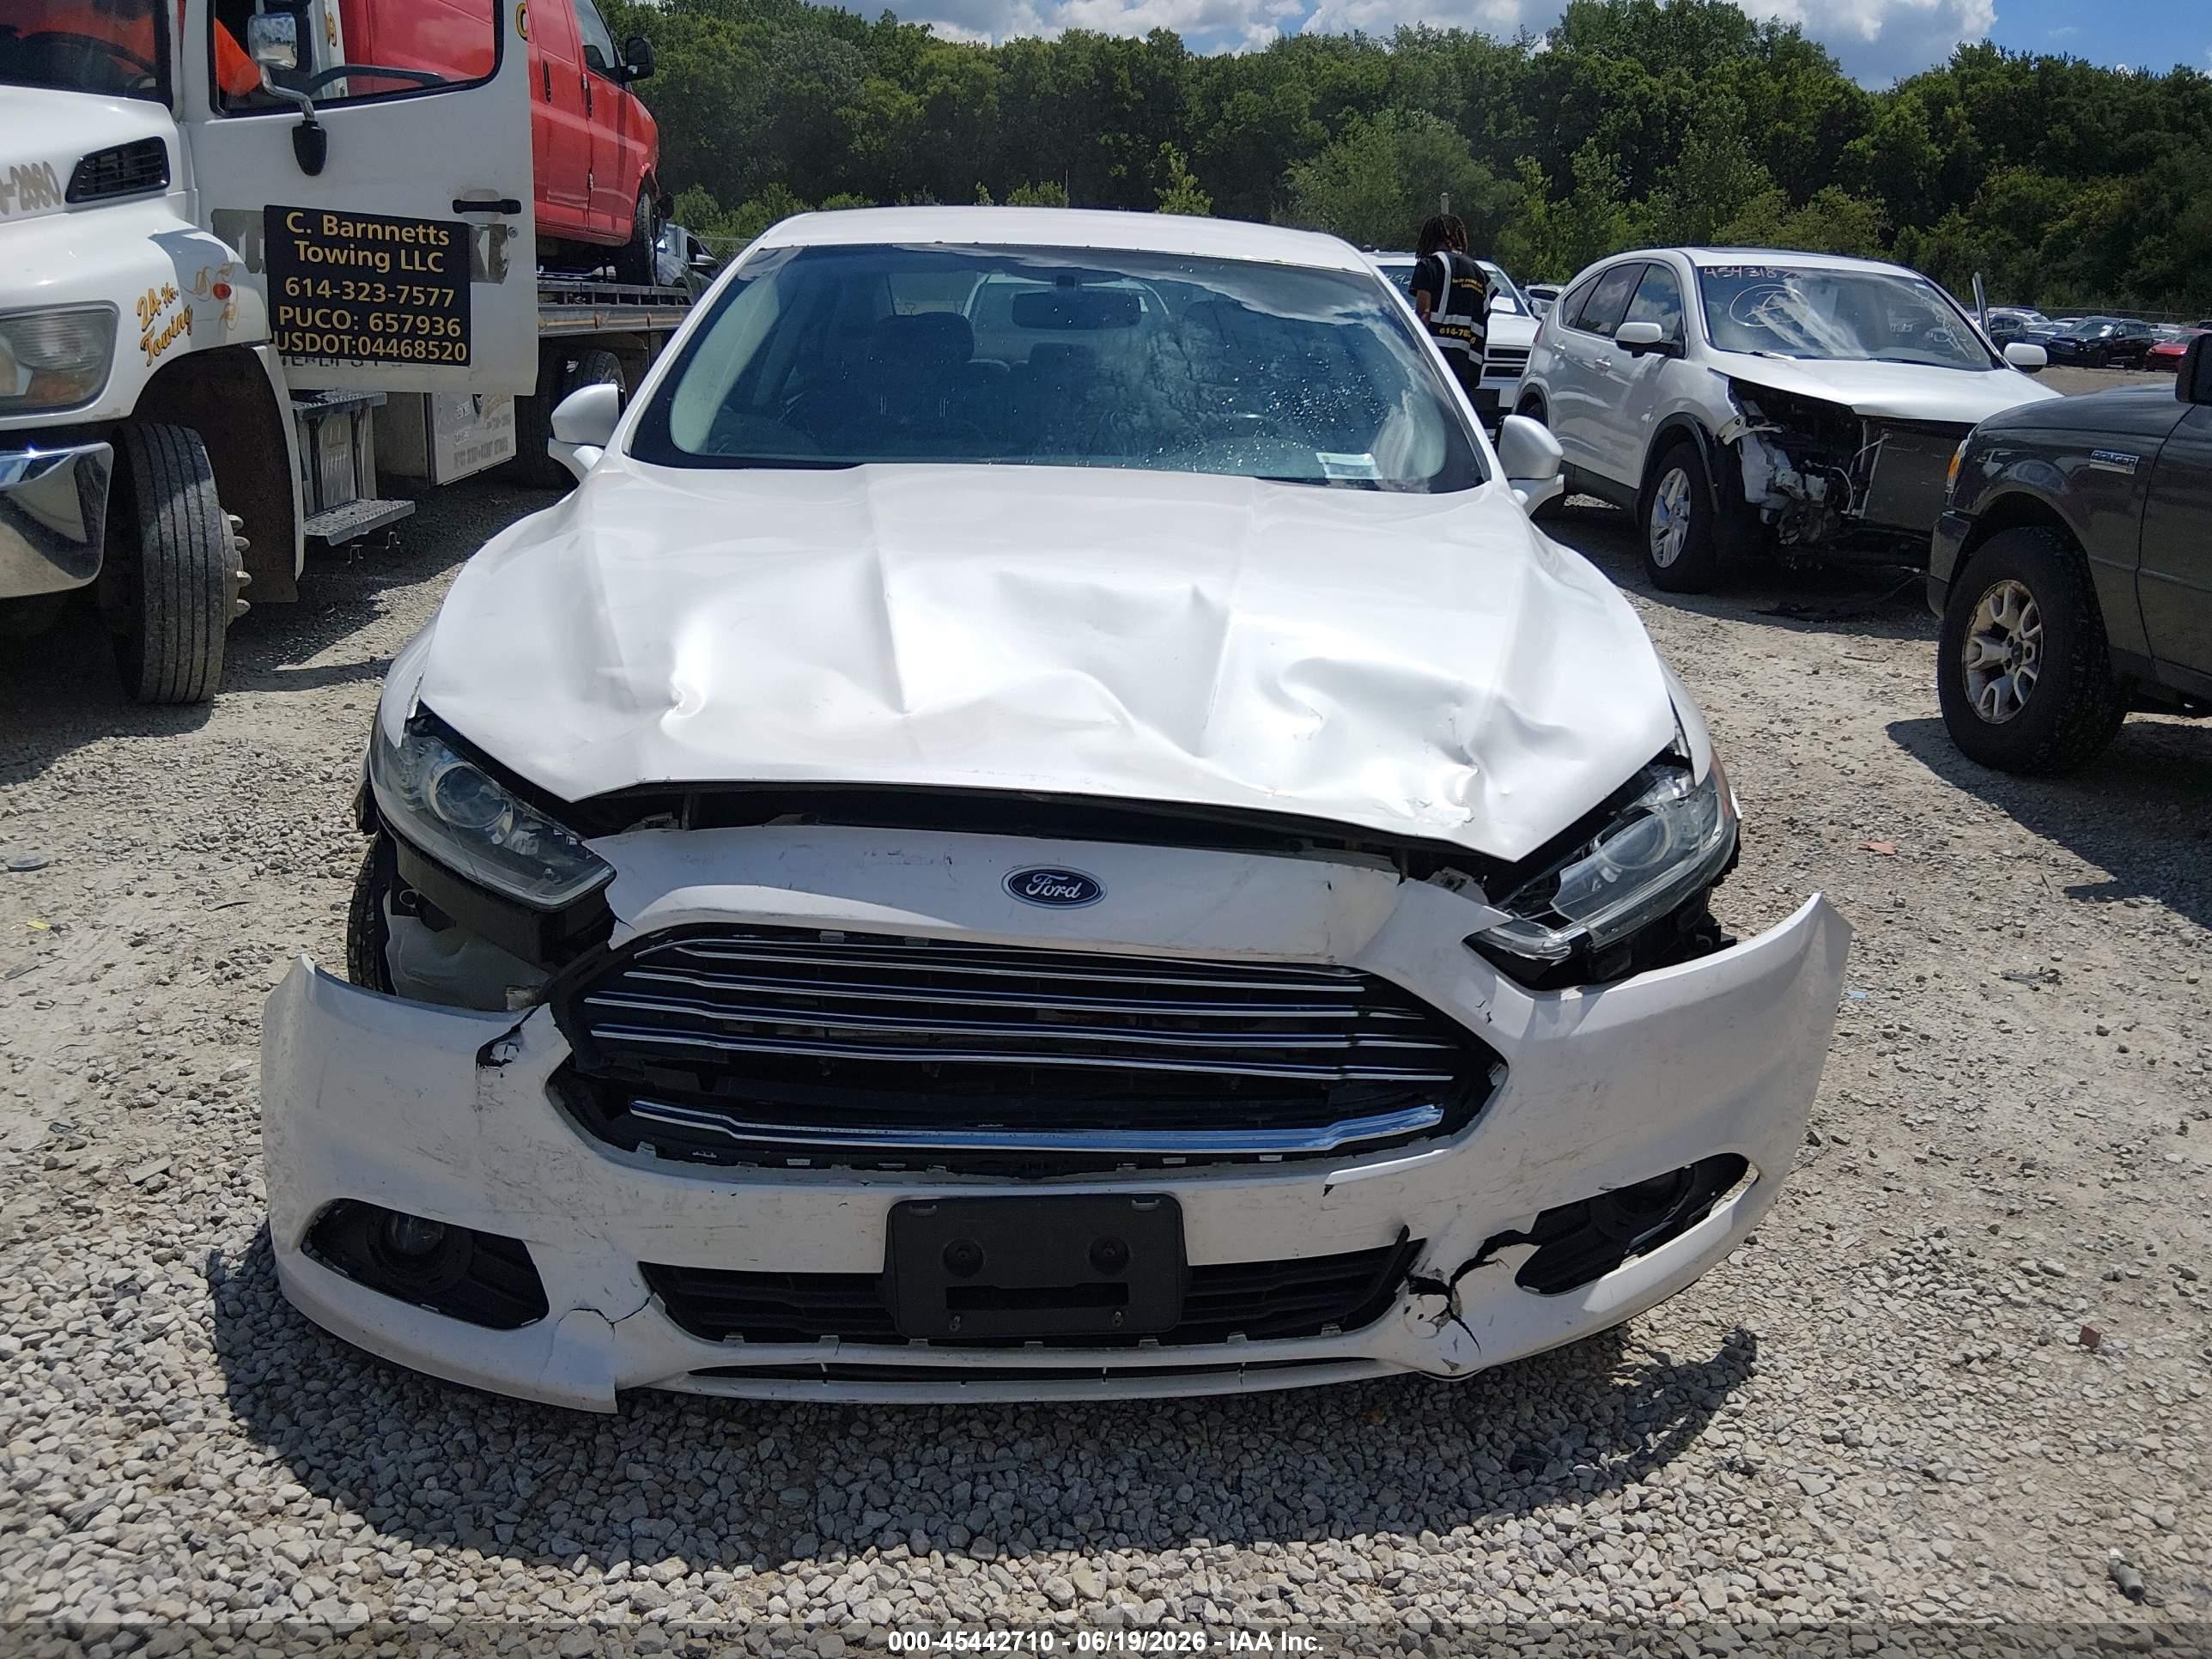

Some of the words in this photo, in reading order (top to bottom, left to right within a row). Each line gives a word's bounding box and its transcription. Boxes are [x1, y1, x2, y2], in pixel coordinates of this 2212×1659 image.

[286, 212, 312, 234] C.
[323, 215, 450, 245] Barnnetts
[294, 240, 391, 273] Towing
[400, 249, 444, 272] LLC
[285, 276, 454, 307] 614-323-7577
[140, 304, 193, 367] Towing
[279, 306, 359, 330] PUCO:
[368, 313, 461, 337] 657936
[274, 331, 467, 361] USDOT:04468520
[1025, 873, 1083, 898] Ford
